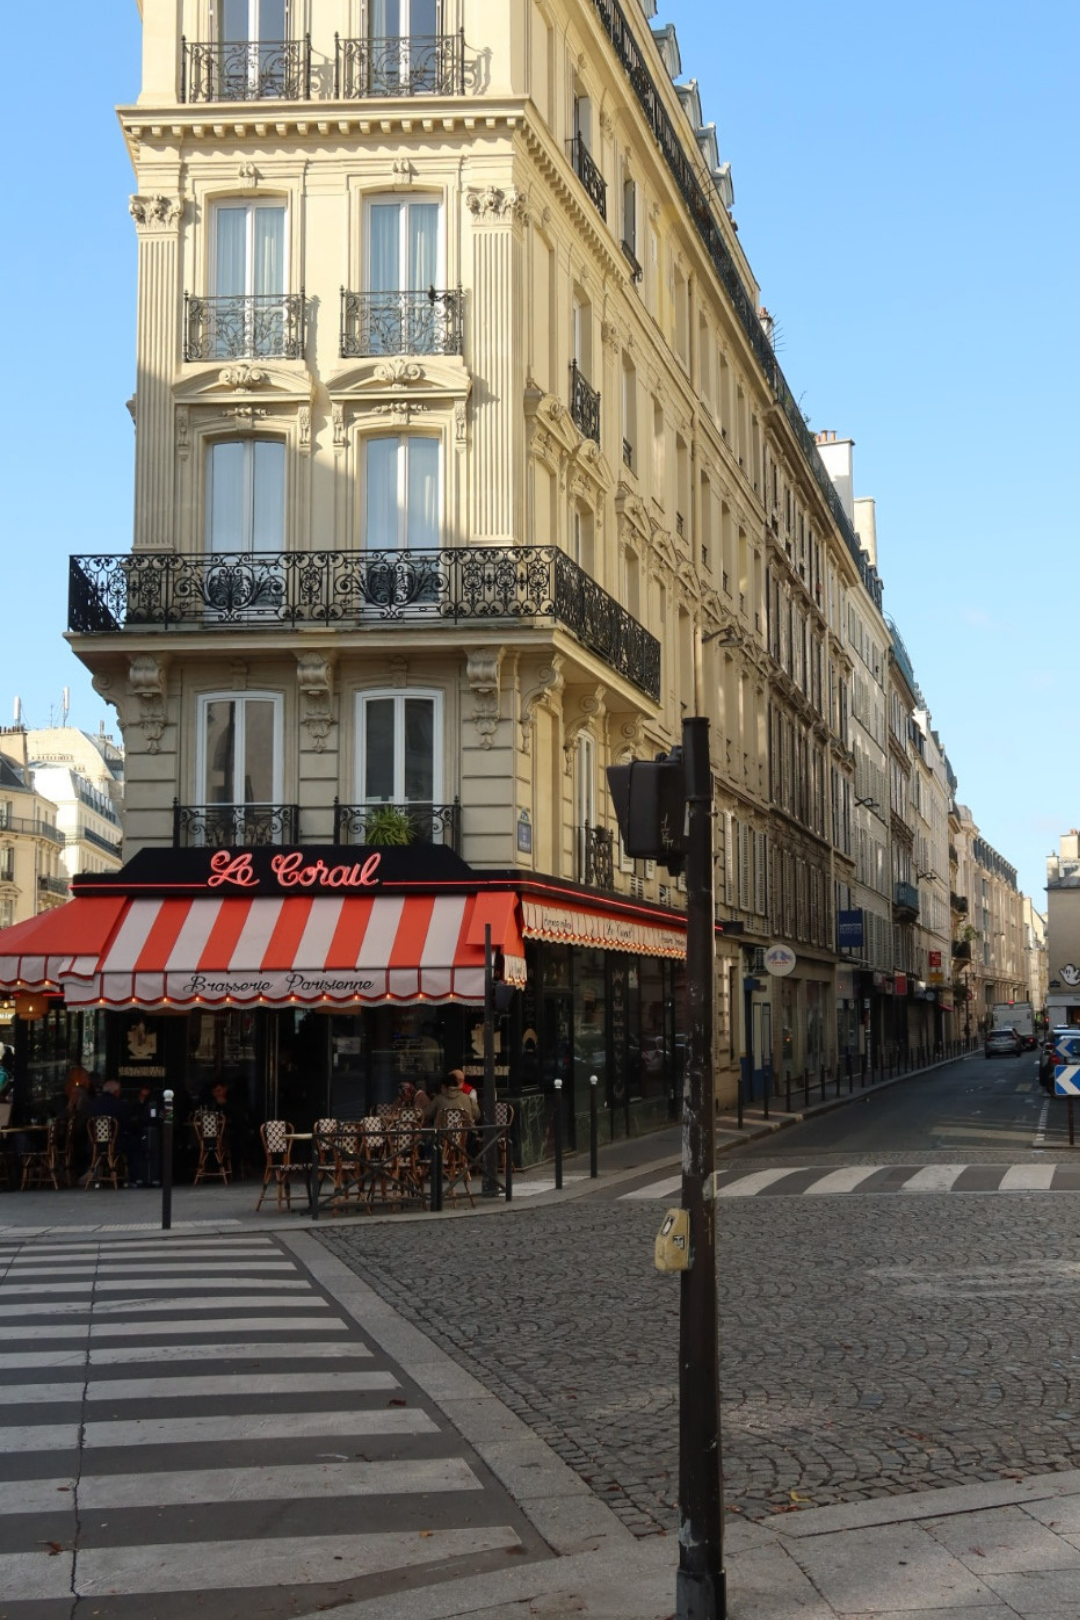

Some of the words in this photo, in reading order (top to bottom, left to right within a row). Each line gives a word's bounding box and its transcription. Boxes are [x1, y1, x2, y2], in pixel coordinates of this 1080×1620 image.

[207, 850, 260, 887] Le
[271, 852, 381, 887] Corail
[183, 975, 273, 993] Brasserie
[285, 973, 374, 992] Parisienne
